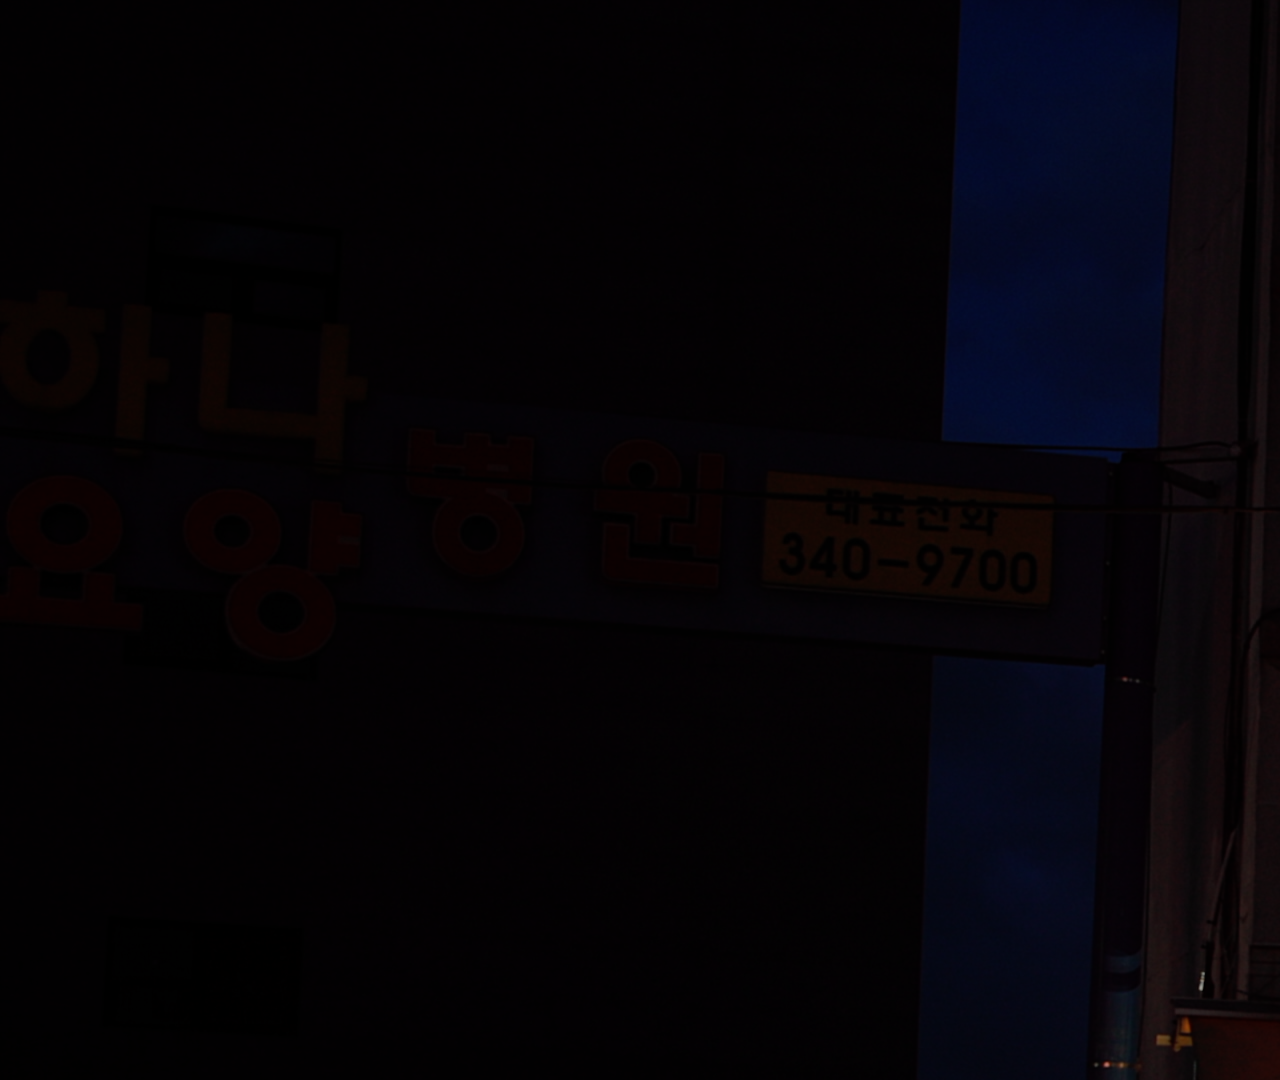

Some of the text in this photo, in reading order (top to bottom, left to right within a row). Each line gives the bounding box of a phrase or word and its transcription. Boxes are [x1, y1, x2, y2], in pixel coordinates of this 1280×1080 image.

[0, 289, 369, 476] 하나
[0, 427, 727, 663] 요양 병원
[778, 534, 1042, 597] 340-9700
[822, 484, 1001, 539] 대표전화
